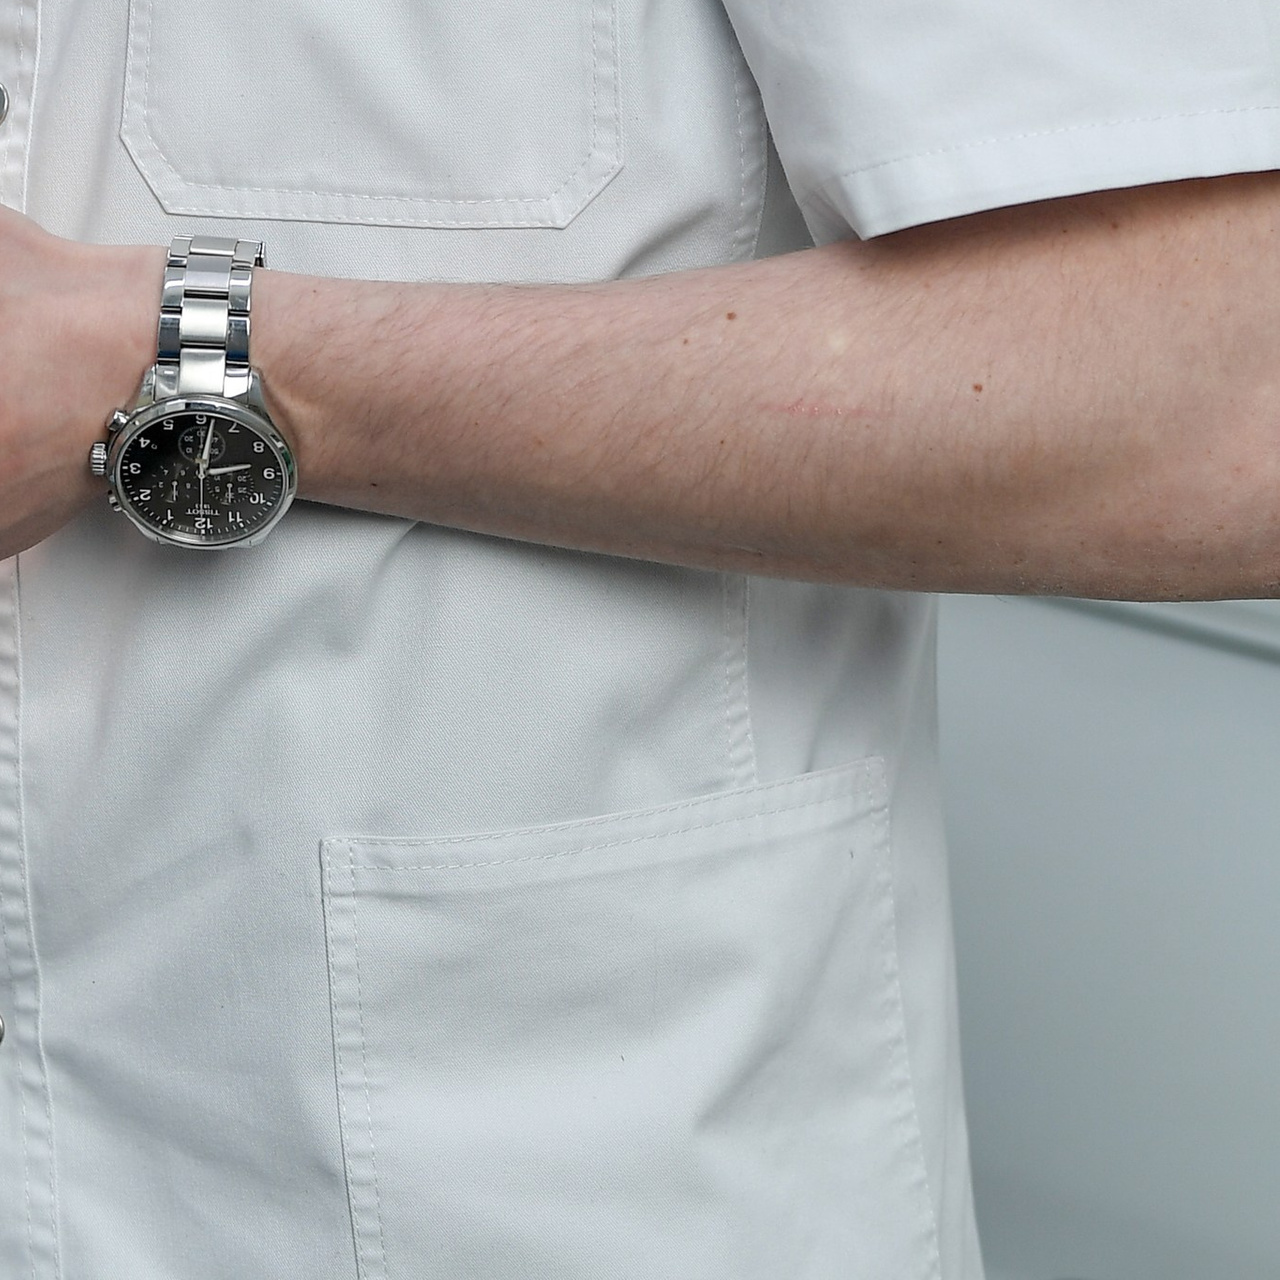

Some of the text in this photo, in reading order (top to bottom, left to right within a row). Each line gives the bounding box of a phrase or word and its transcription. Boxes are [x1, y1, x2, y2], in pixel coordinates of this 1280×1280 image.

[163, 419, 174, 430] 5
[196, 415, 207, 424] 6
[228, 423, 240, 433] 7
[139, 437, 150, 447] 4
[253, 442, 264, 452] 8
[130, 463, 141, 474] 3
[263, 468, 275, 479] 9
[140, 489, 151, 501] 2
[250, 493, 266, 504] 10
[167, 510, 174, 520] 1
[229, 512, 243, 522] 11
[195, 518, 213, 529] 12
